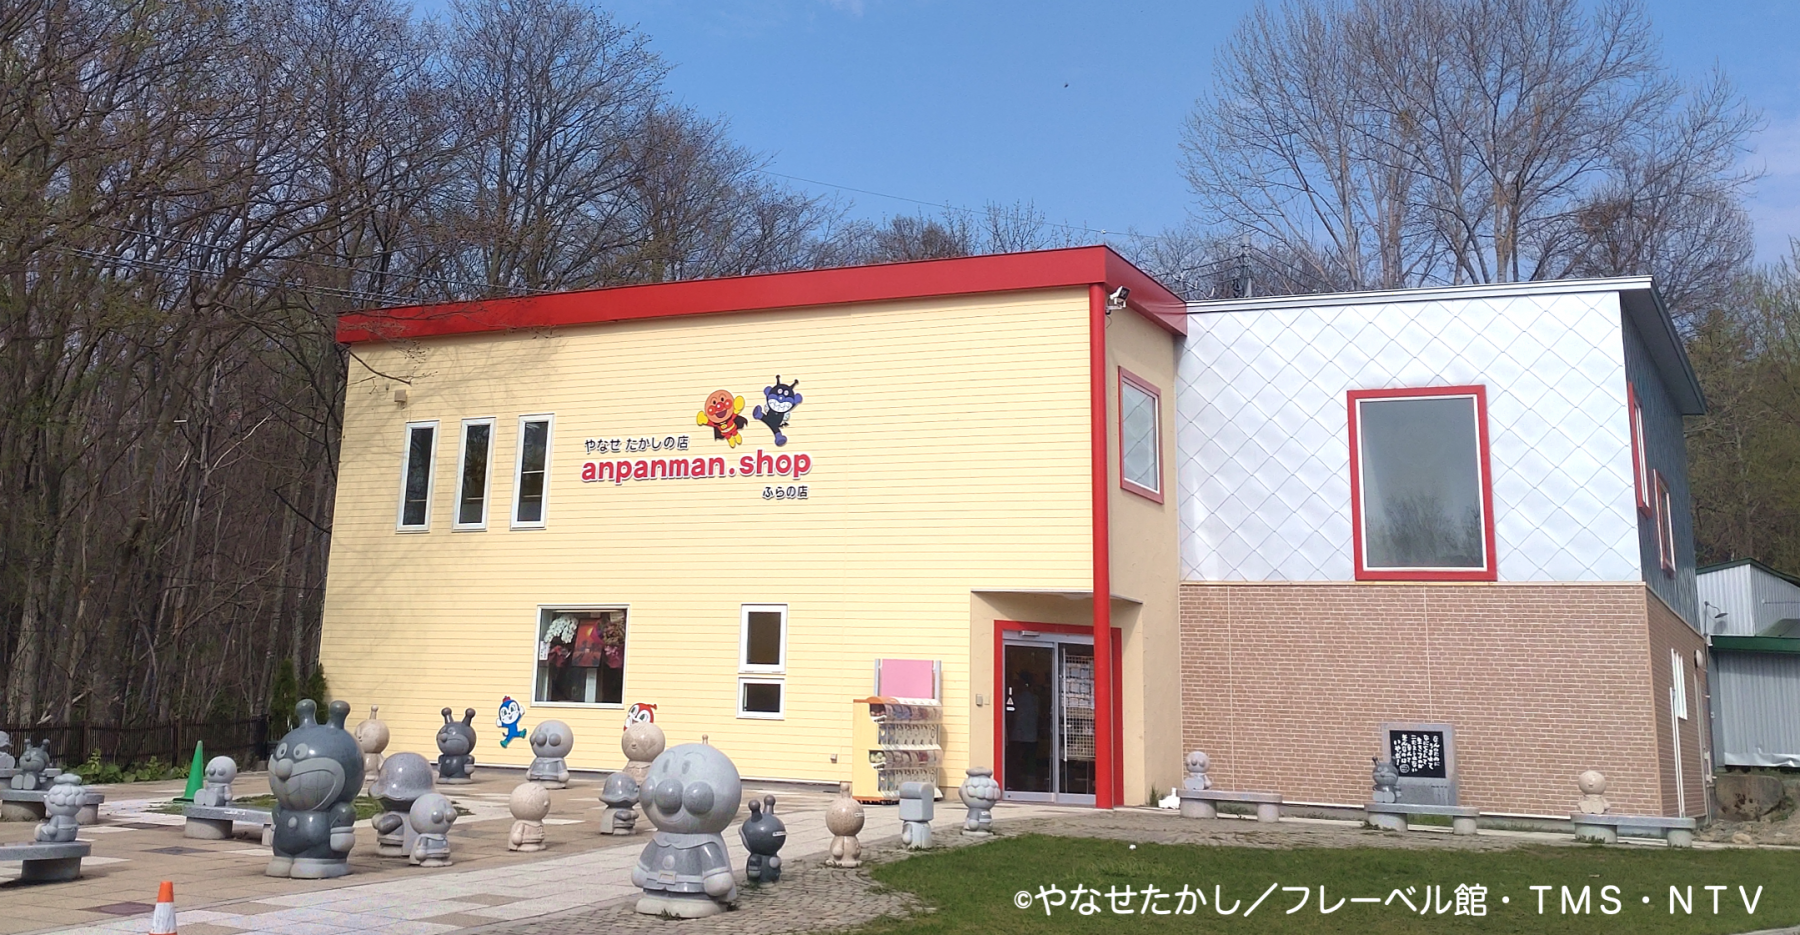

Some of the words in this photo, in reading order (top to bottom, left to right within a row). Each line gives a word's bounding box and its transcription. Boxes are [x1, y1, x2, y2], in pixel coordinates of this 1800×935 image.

[585, 438, 621, 453] やなせ
[625, 436, 689, 451] たかしの店
[581, 449, 811, 484] anpanman.shop
[762, 486, 808, 499] ふらの店
